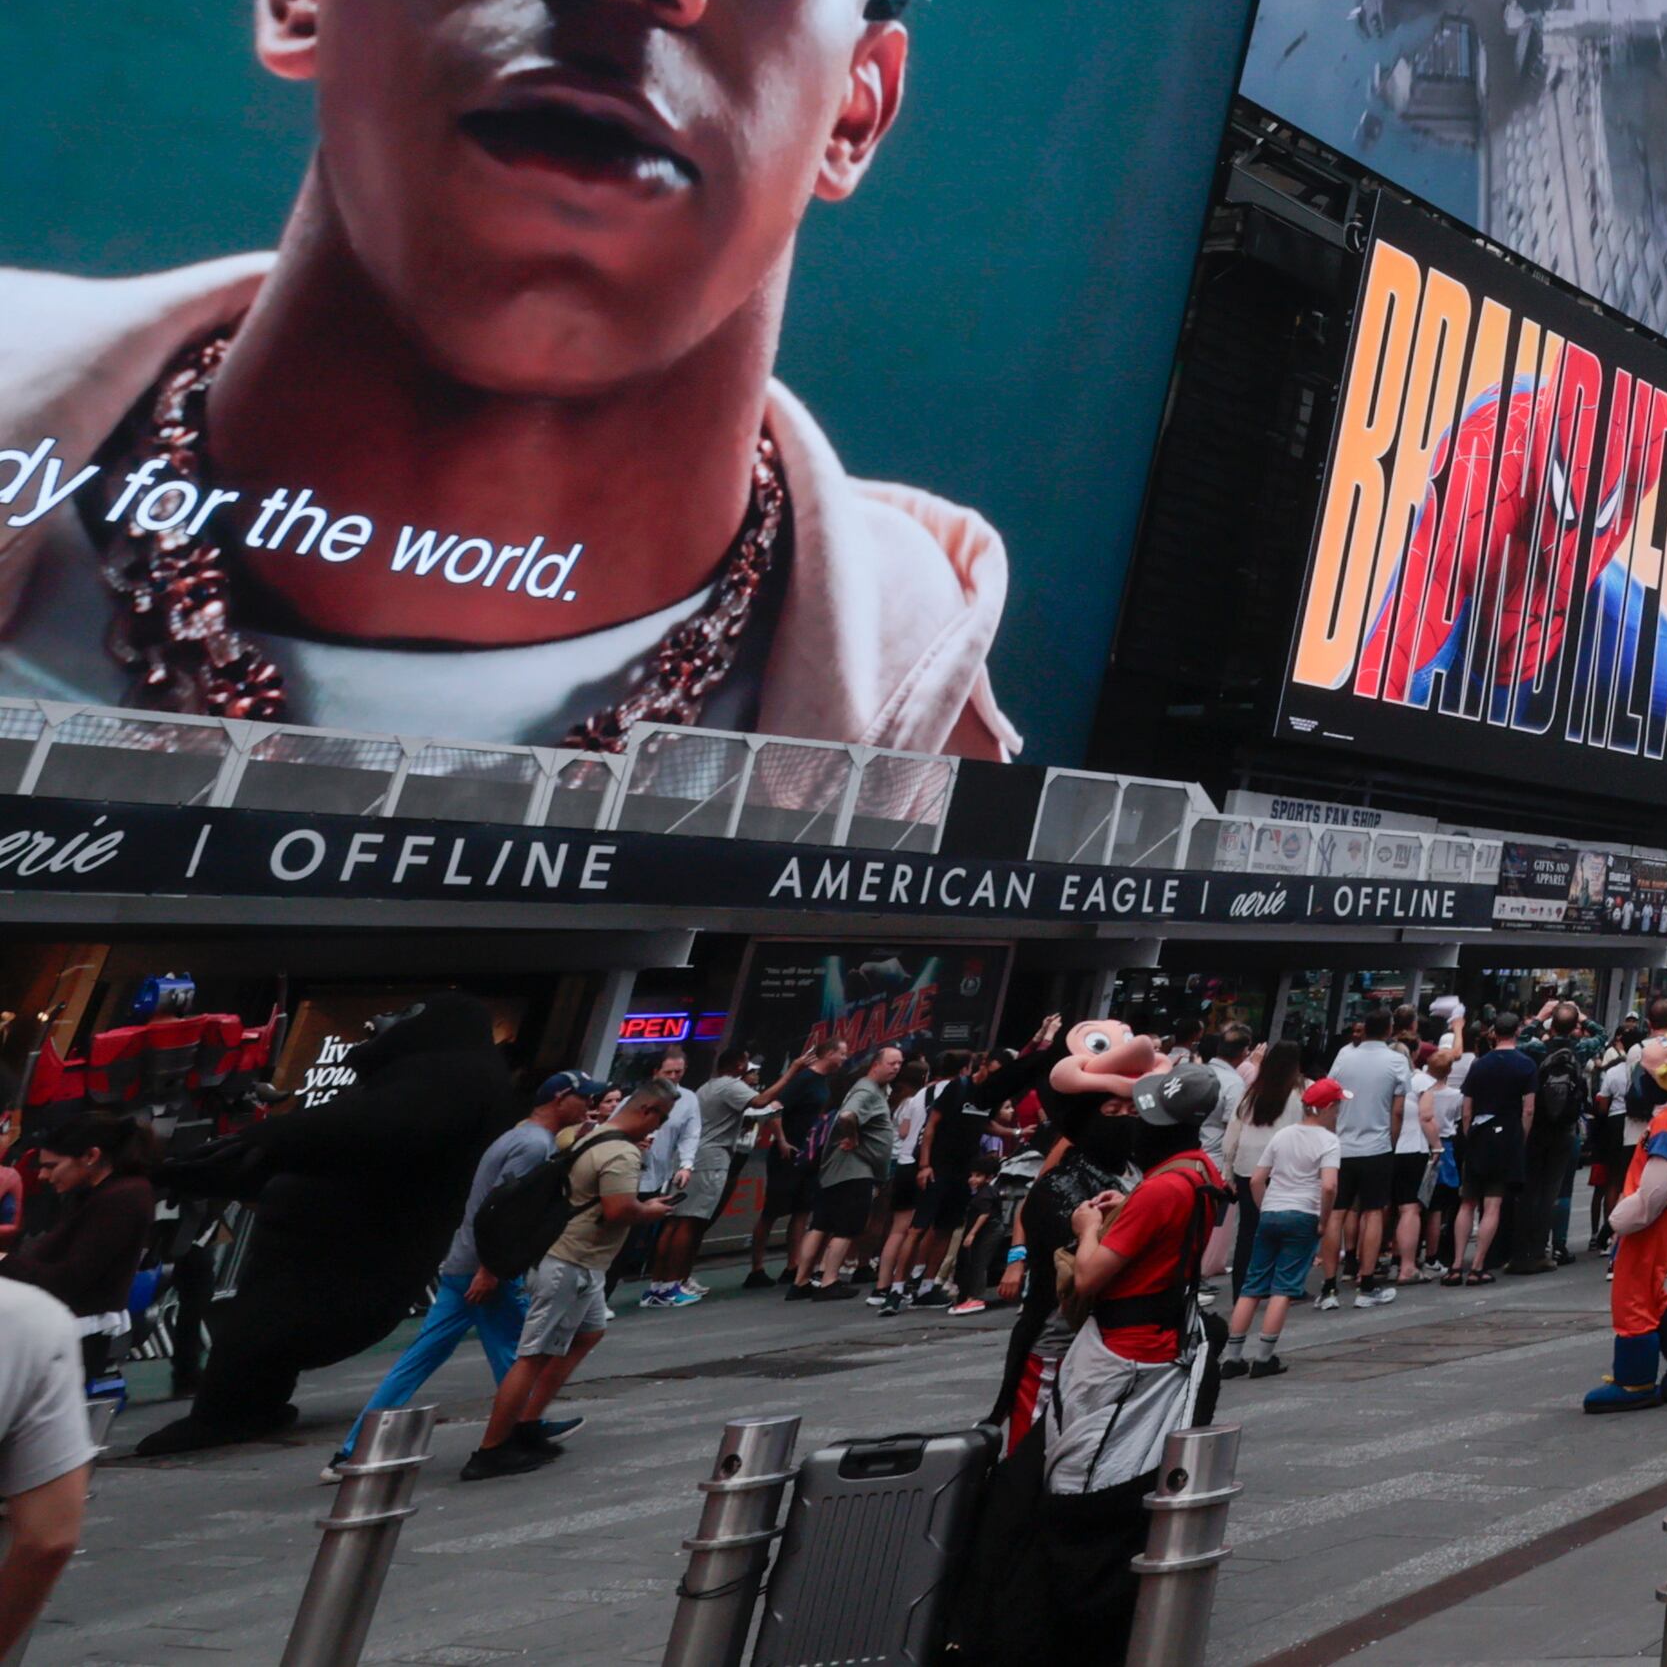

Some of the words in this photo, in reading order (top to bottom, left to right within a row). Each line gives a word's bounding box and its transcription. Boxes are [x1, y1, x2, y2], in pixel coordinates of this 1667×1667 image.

[1292, 238, 1603, 736] BRAND
[105, 459, 240, 536] for
[243, 488, 374, 563] the
[390, 525, 584, 601] world.
[1270, 799, 1321, 823] SPORTS
[1324, 807, 1350, 826] FAN
[1352, 810, 1382, 828] SHOP
[269, 829, 618, 891] OFFLINE
[768, 856, 1037, 911] AMERICAN
[1058, 874, 1181, 914] EAGLE
[1229, 881, 1288, 918] aerie
[1333, 885, 1456, 919] OFFLINE
[1533, 860, 1553, 872] GIFTS
[801, 984, 938, 1059] AMAZE
